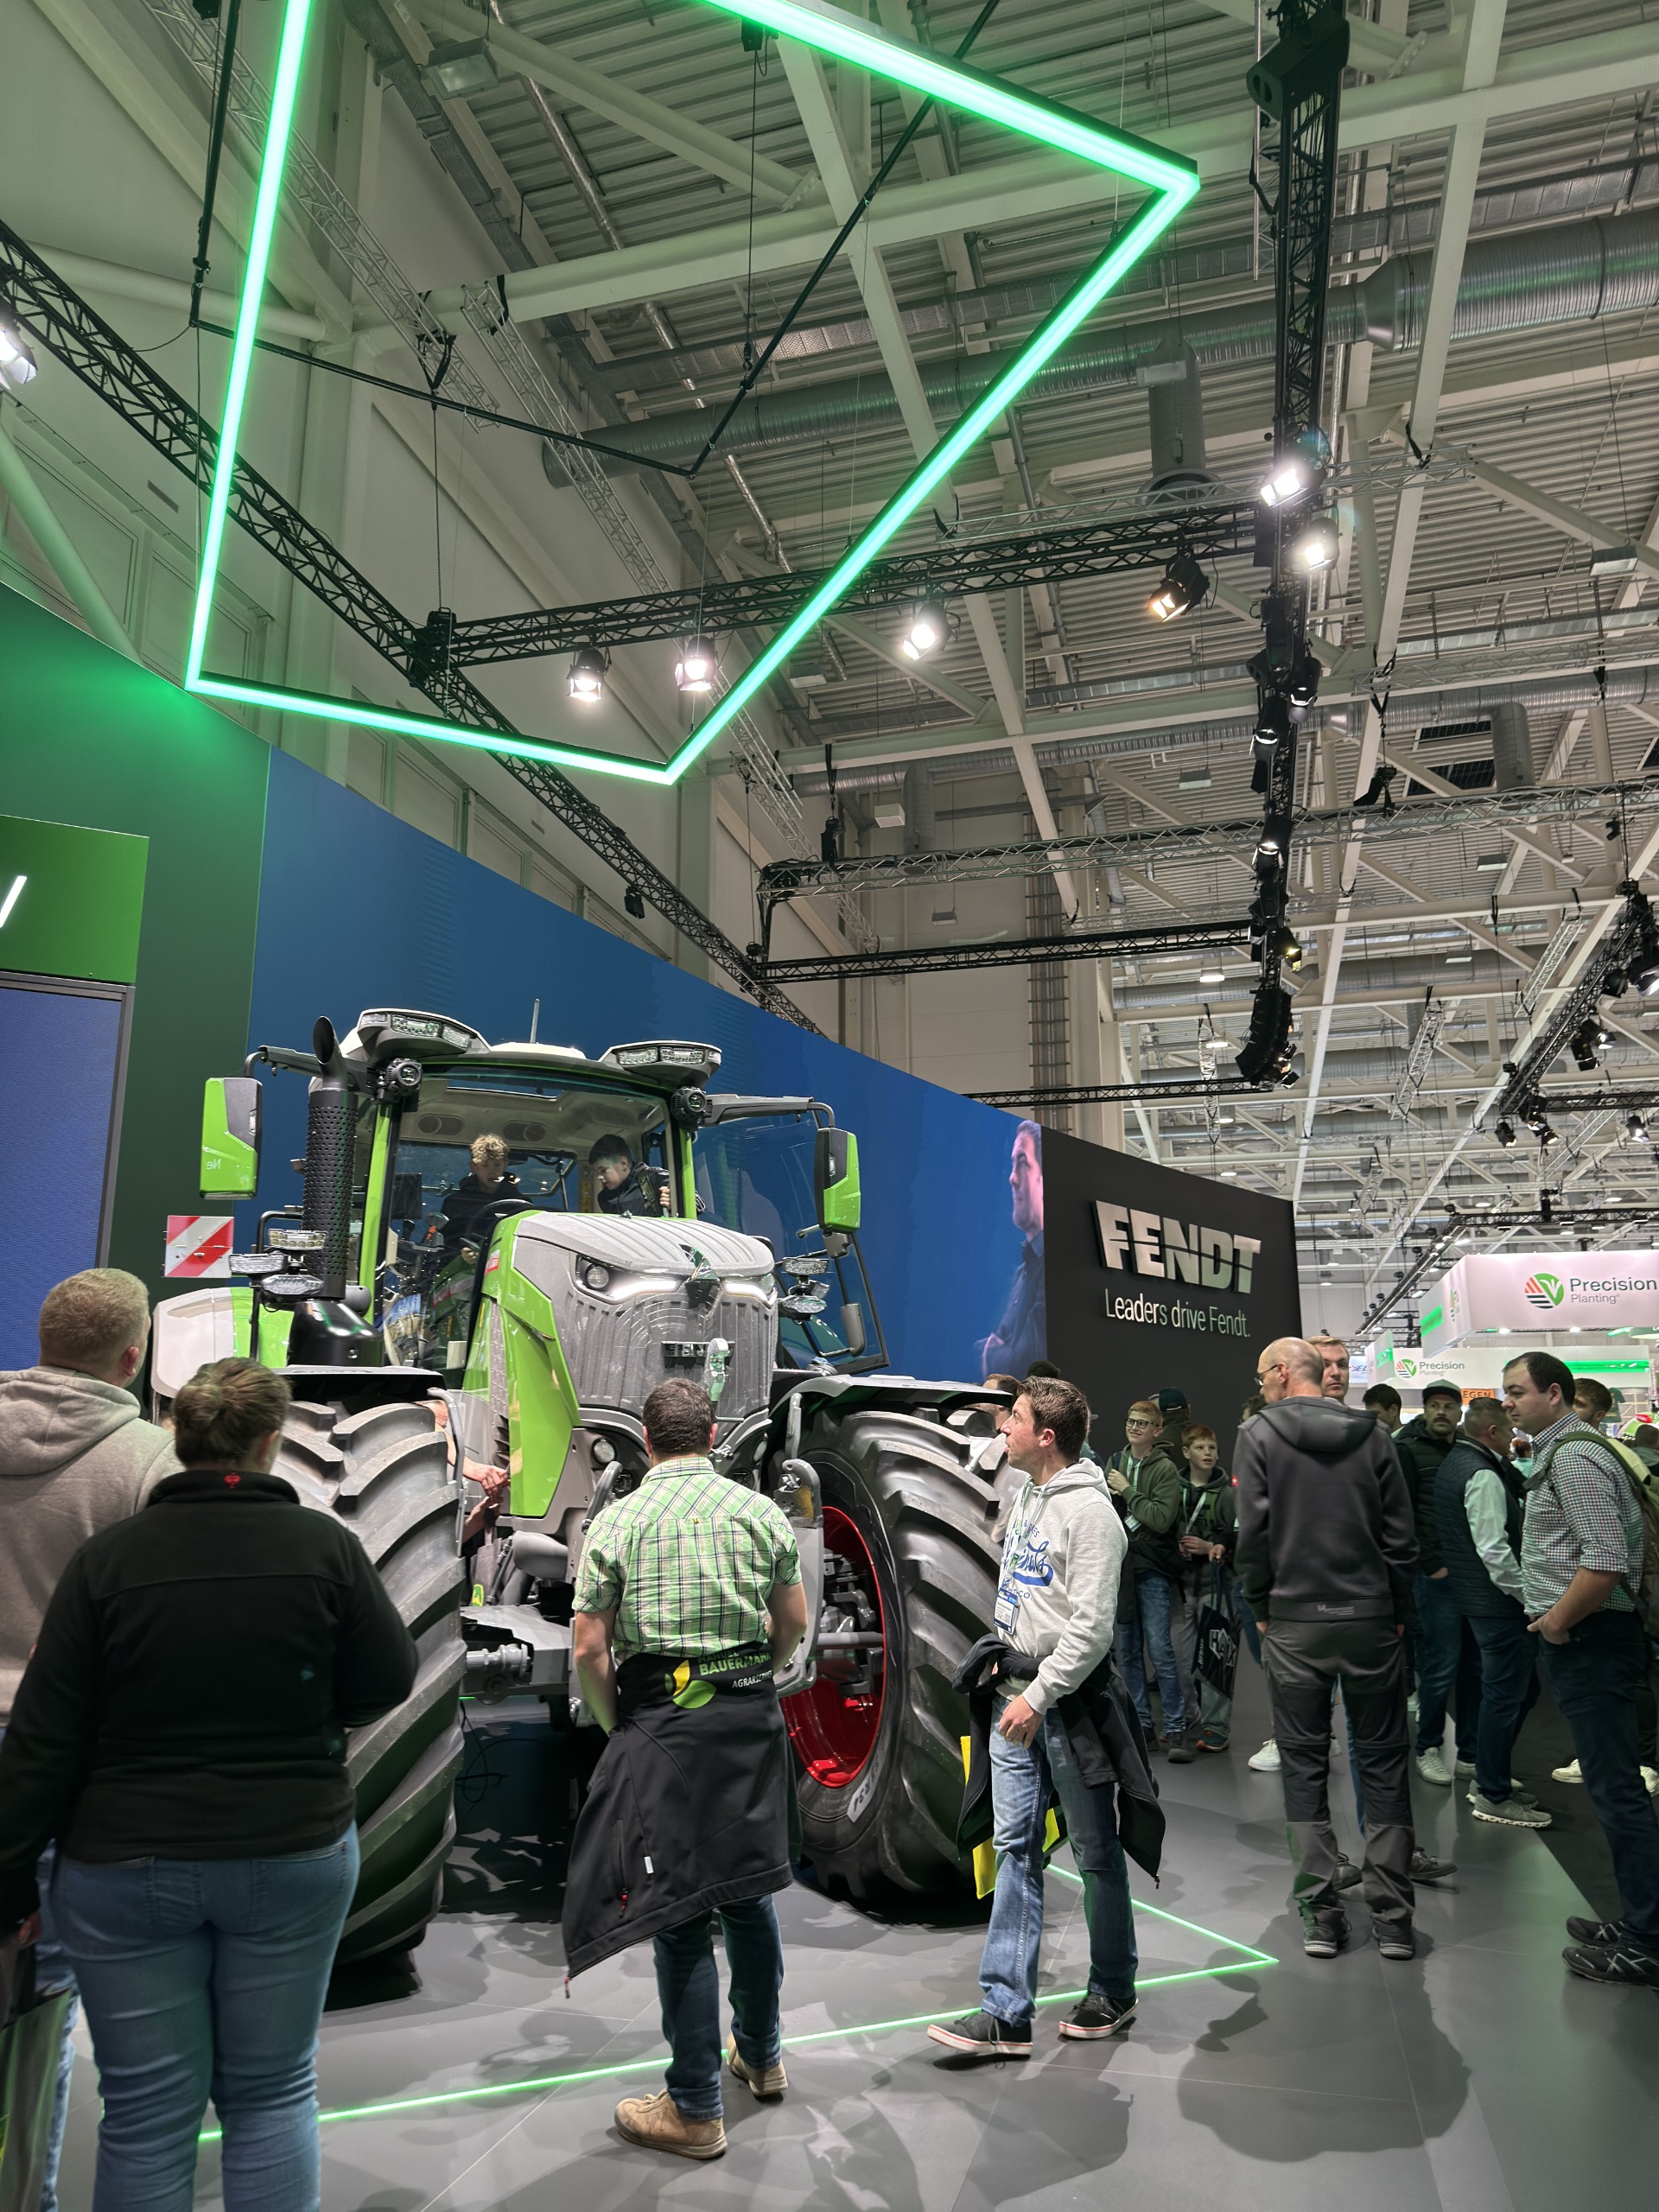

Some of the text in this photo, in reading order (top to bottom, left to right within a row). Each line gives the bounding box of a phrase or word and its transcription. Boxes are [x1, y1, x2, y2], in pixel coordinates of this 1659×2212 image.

[1093, 1199, 1262, 1294] FENDT
[1569, 1276, 1658, 1292] Precision
[1104, 1287, 1251, 1338] Leaders drive Fendt.
[1419, 1361, 1465, 1370] Precision
